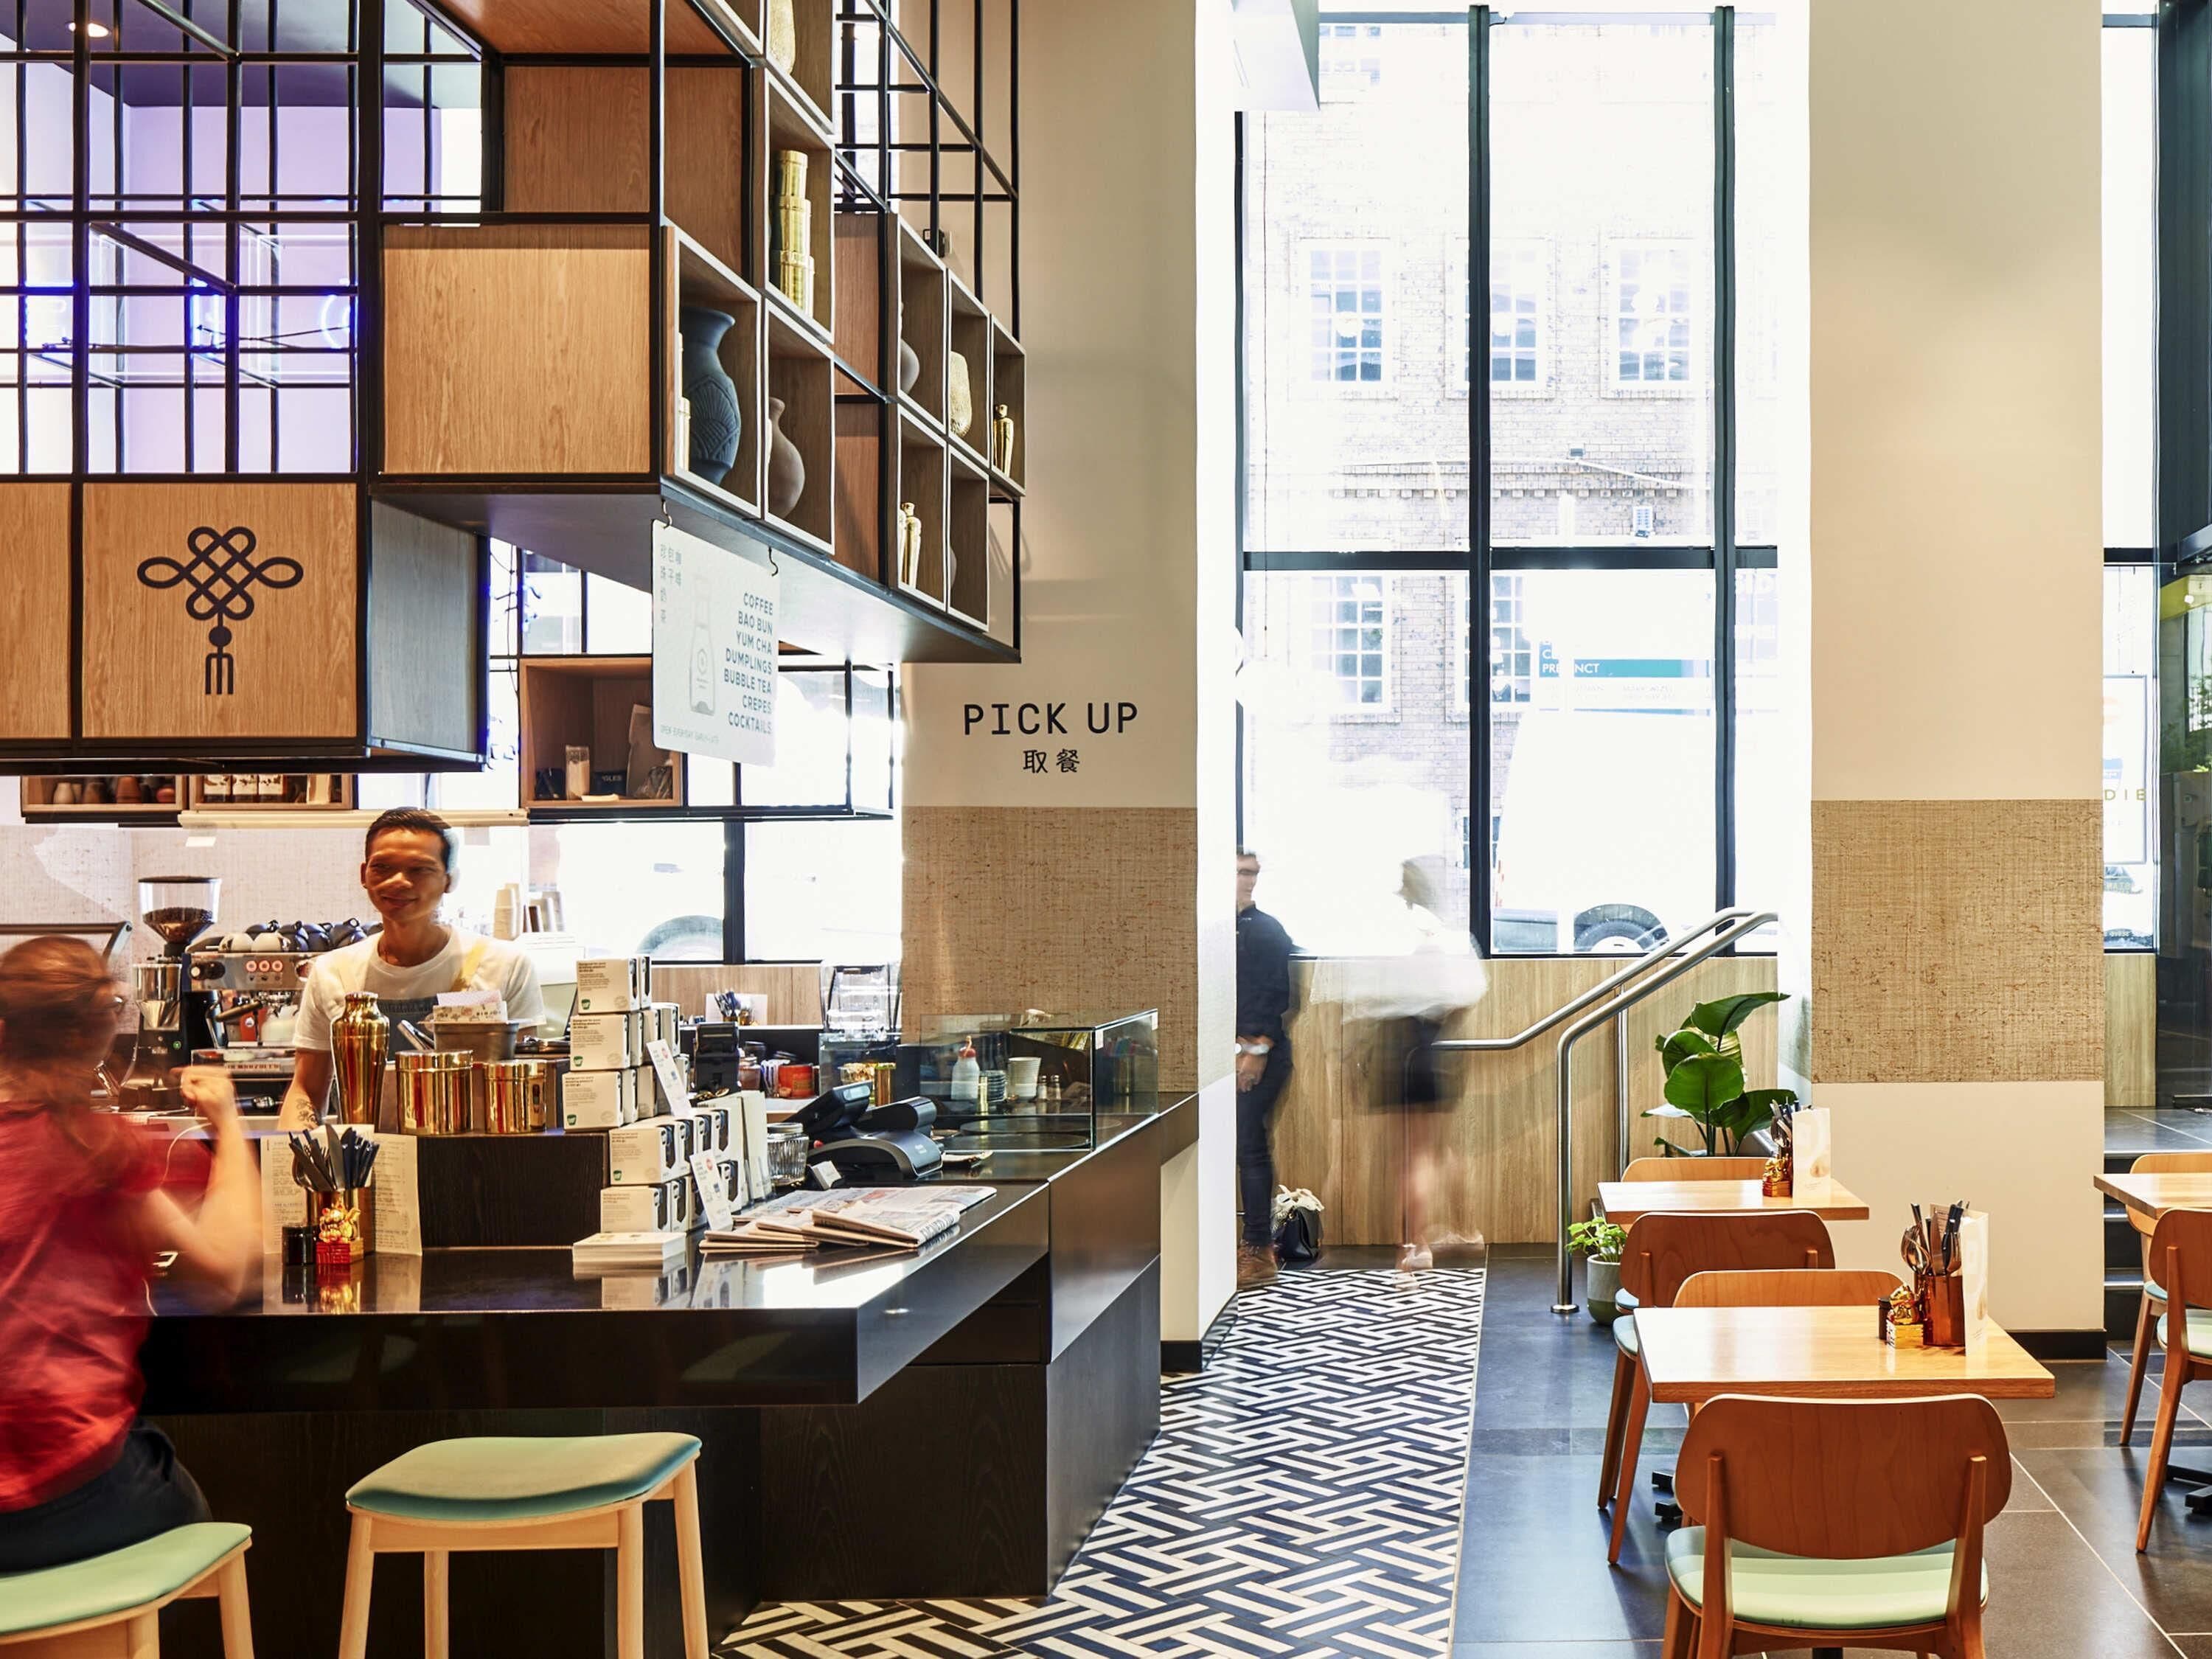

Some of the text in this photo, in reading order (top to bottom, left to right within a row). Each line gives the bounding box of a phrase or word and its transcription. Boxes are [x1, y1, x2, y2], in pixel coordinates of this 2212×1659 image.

[743, 592, 773, 616] COFFEE
[738, 611, 773, 636] BAO BUN
[736, 629, 772, 655] YUM CHA
[726, 647, 772, 675] DUMPLINGS
[723, 668, 755, 690] BUBBLE
[757, 678, 771, 695] TEA
[742, 695, 772, 714] CREPES
[728, 712, 772, 734] COCKTAILS
[964, 702, 1138, 735] PICK UP
[1023, 748, 1080, 773] 取餐
